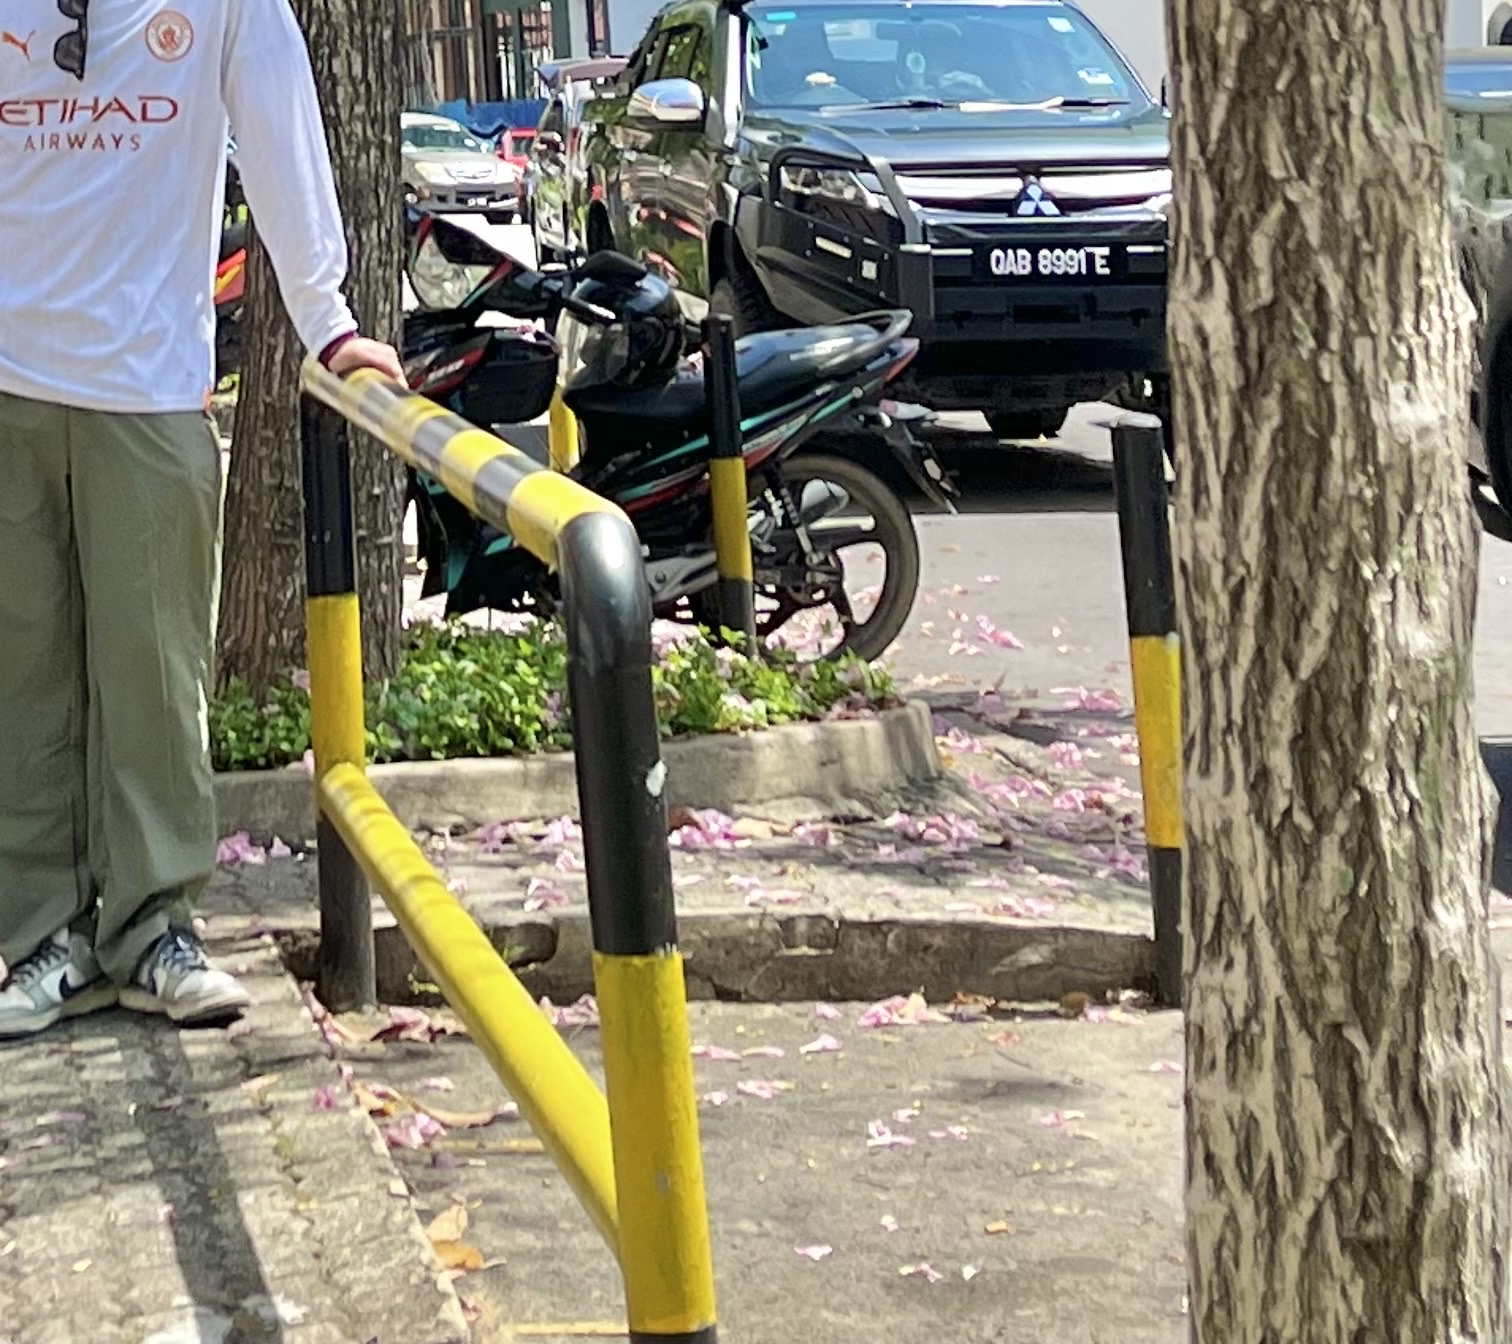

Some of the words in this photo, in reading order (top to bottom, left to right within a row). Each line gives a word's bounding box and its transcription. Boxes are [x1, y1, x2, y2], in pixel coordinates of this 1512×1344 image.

[23, 132, 142, 153] AIRWAYS
[990, 248, 1032, 276] QAB
[1037, 247, 1087, 275] 8991
